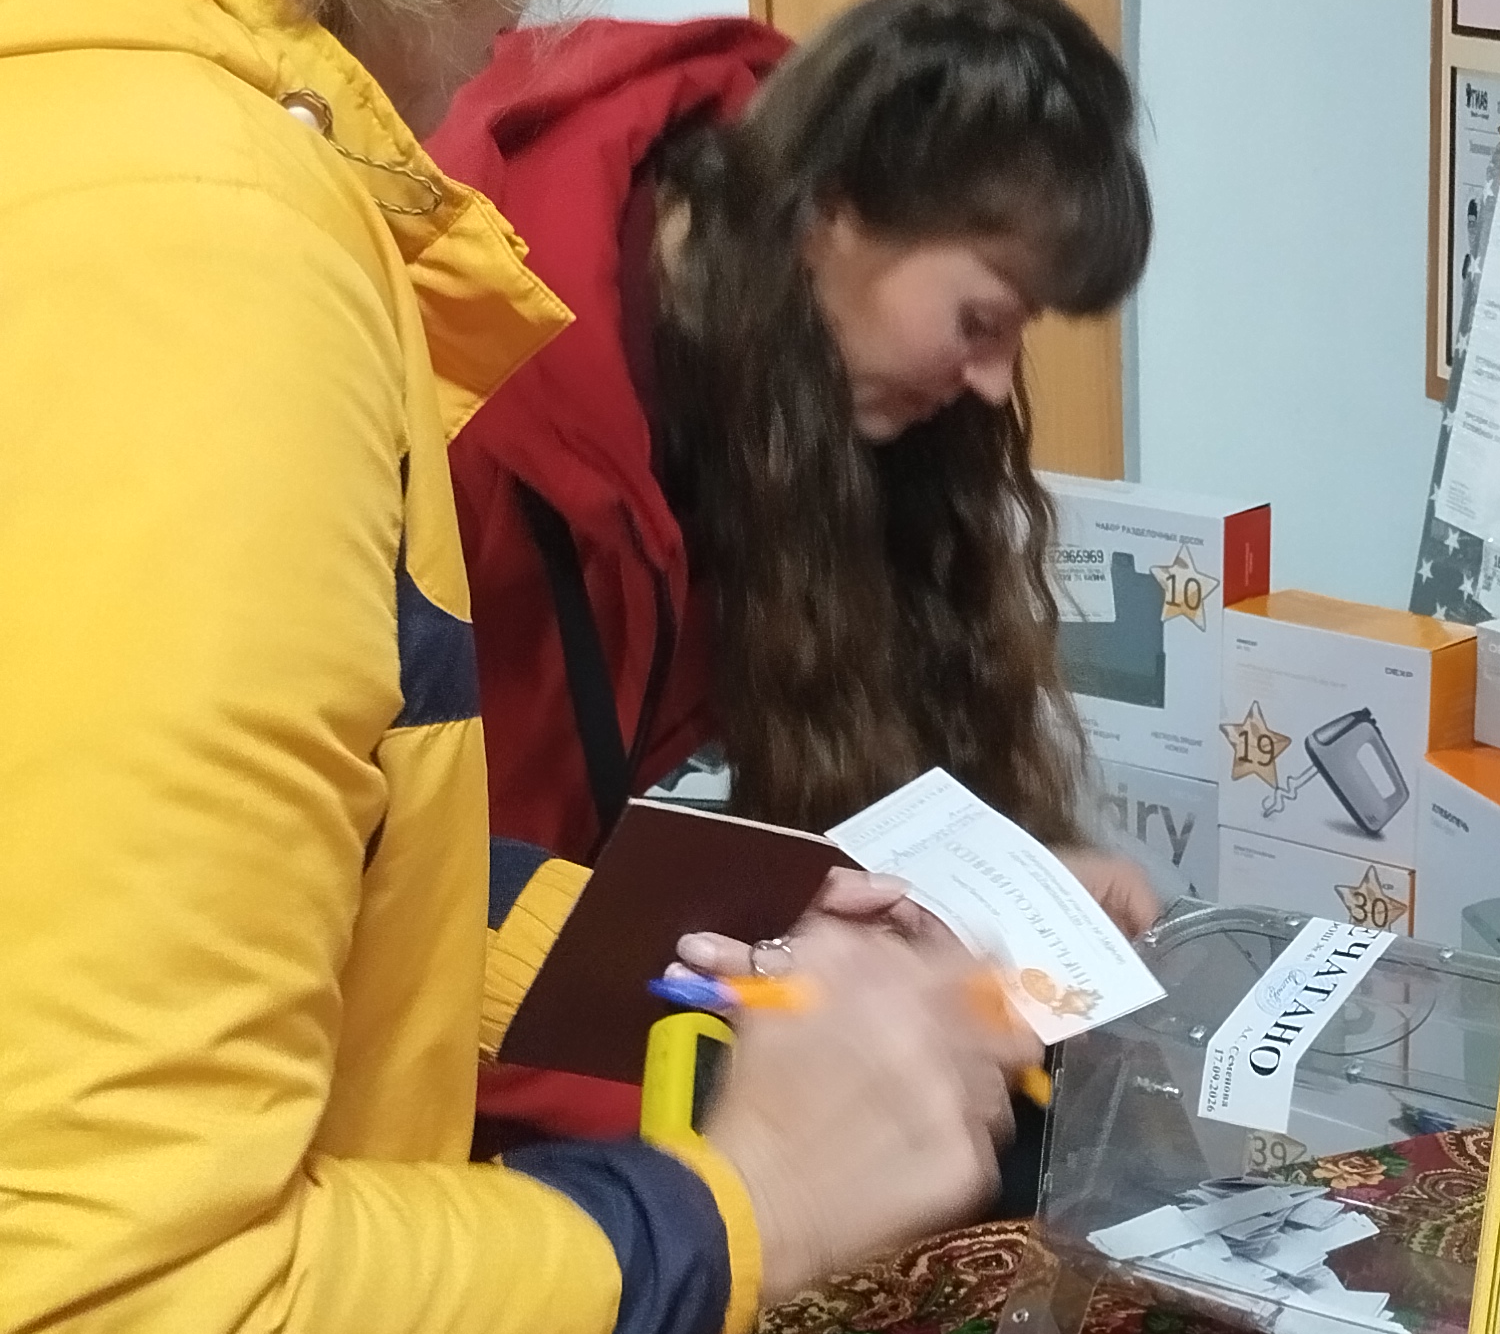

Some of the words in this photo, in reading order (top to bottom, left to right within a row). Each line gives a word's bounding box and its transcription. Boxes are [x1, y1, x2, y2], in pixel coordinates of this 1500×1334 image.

[1042, 548, 1104, 564] 2965969
[1165, 573, 1202, 611] 10
[1385, 667, 1414, 678] DEXP
[1238, 730, 1275, 766] 19
[1353, 891, 1389, 928] 30
[1249, 924, 1379, 1076] ЕЧАТАНО
[1206, 1048, 1225, 1113] 17.09.2026
[1251, 1135, 1288, 1165] 39
